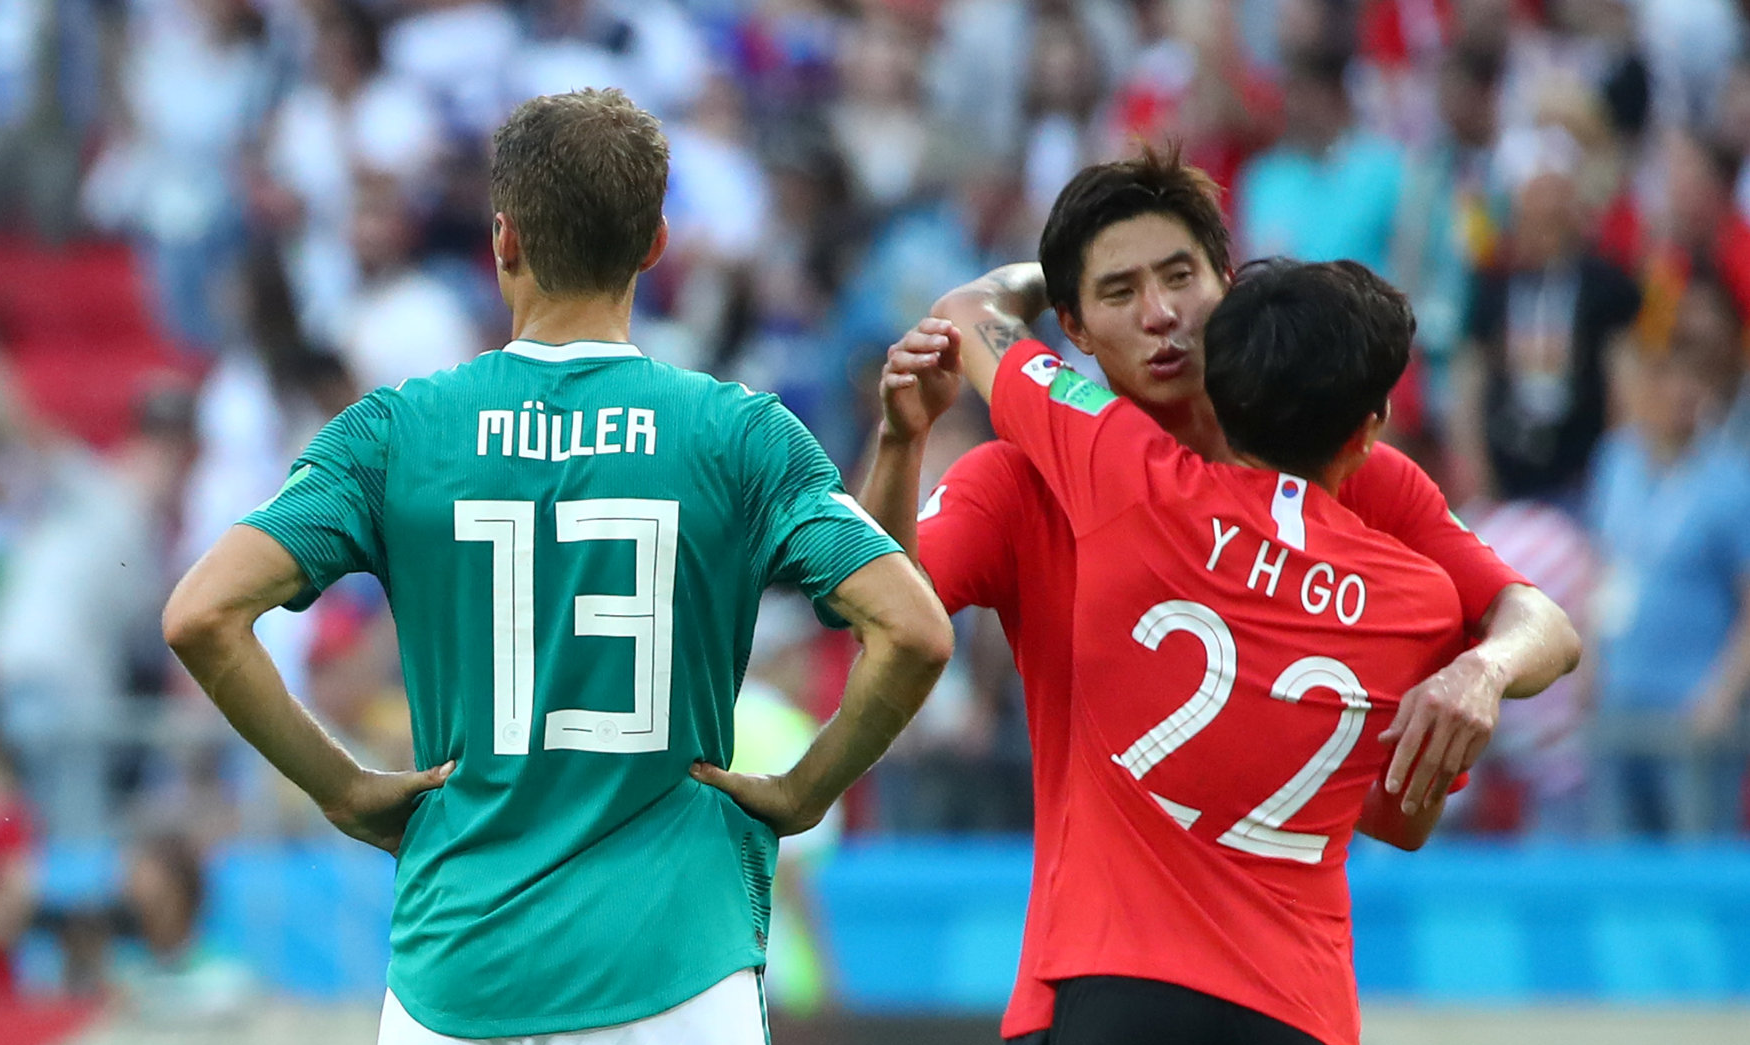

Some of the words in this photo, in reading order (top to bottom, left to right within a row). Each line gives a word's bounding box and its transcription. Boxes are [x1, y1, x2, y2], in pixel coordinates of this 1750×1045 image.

[477, 401, 656, 461] MÜLLER
[454, 500, 680, 755] 13
[1206, 517, 1240, 572] Y
[1246, 540, 1291, 598] H
[1300, 561, 1366, 625] GO
[1111, 599, 1372, 864] 22
